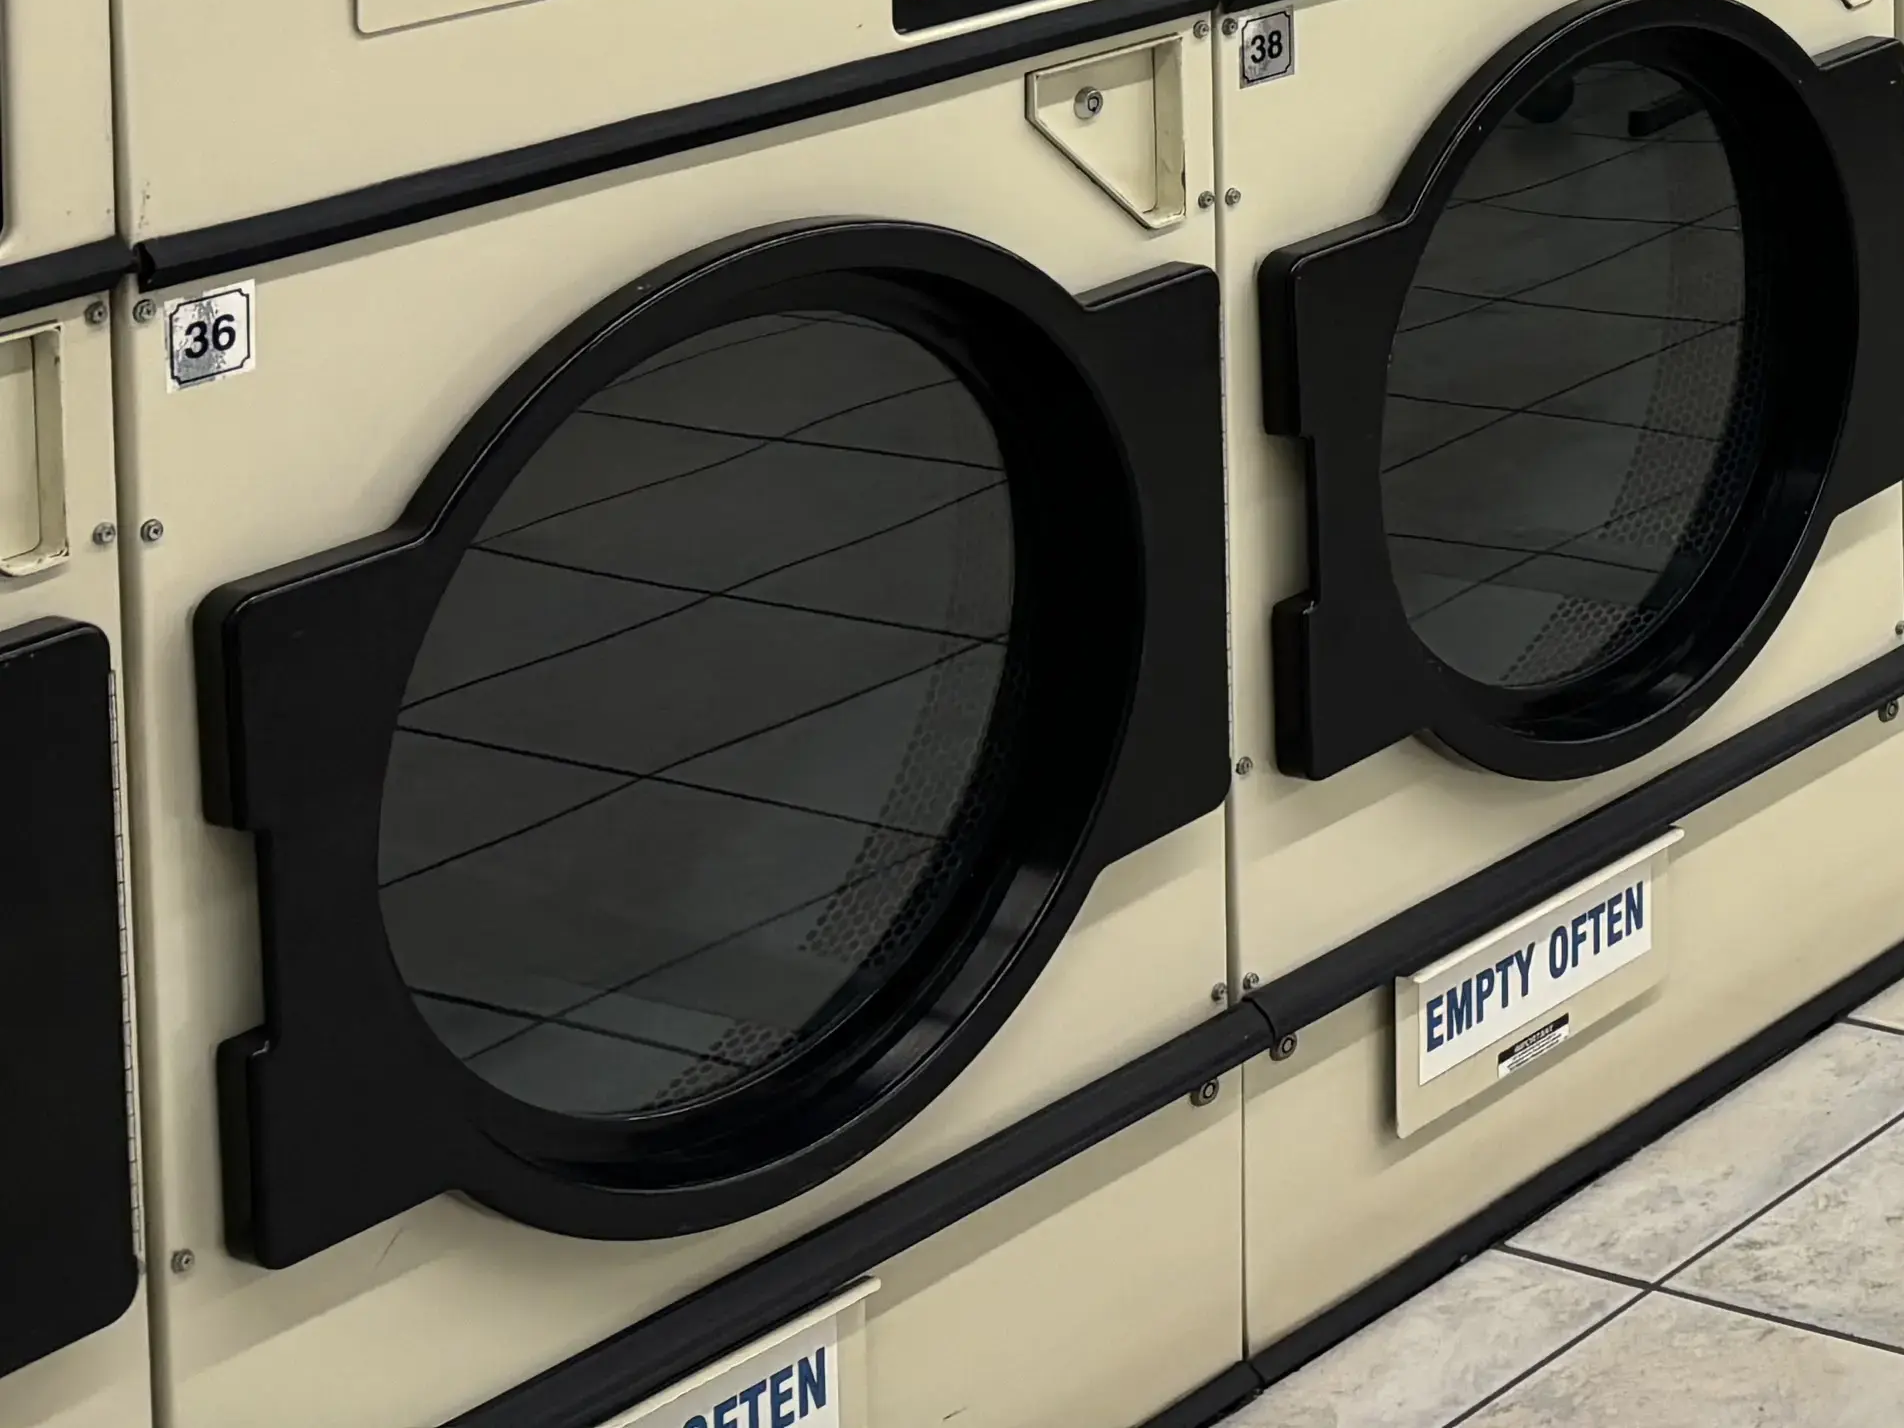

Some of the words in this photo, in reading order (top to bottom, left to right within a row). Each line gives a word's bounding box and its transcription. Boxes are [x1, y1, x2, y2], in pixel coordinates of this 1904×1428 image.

[1251, 30, 1283, 64] 38
[185, 314, 236, 359] 36
[1426, 941, 1536, 1053] EMPTY
[1549, 880, 1643, 979] OFTEN
[682, 1346, 827, 1428] FTEN
